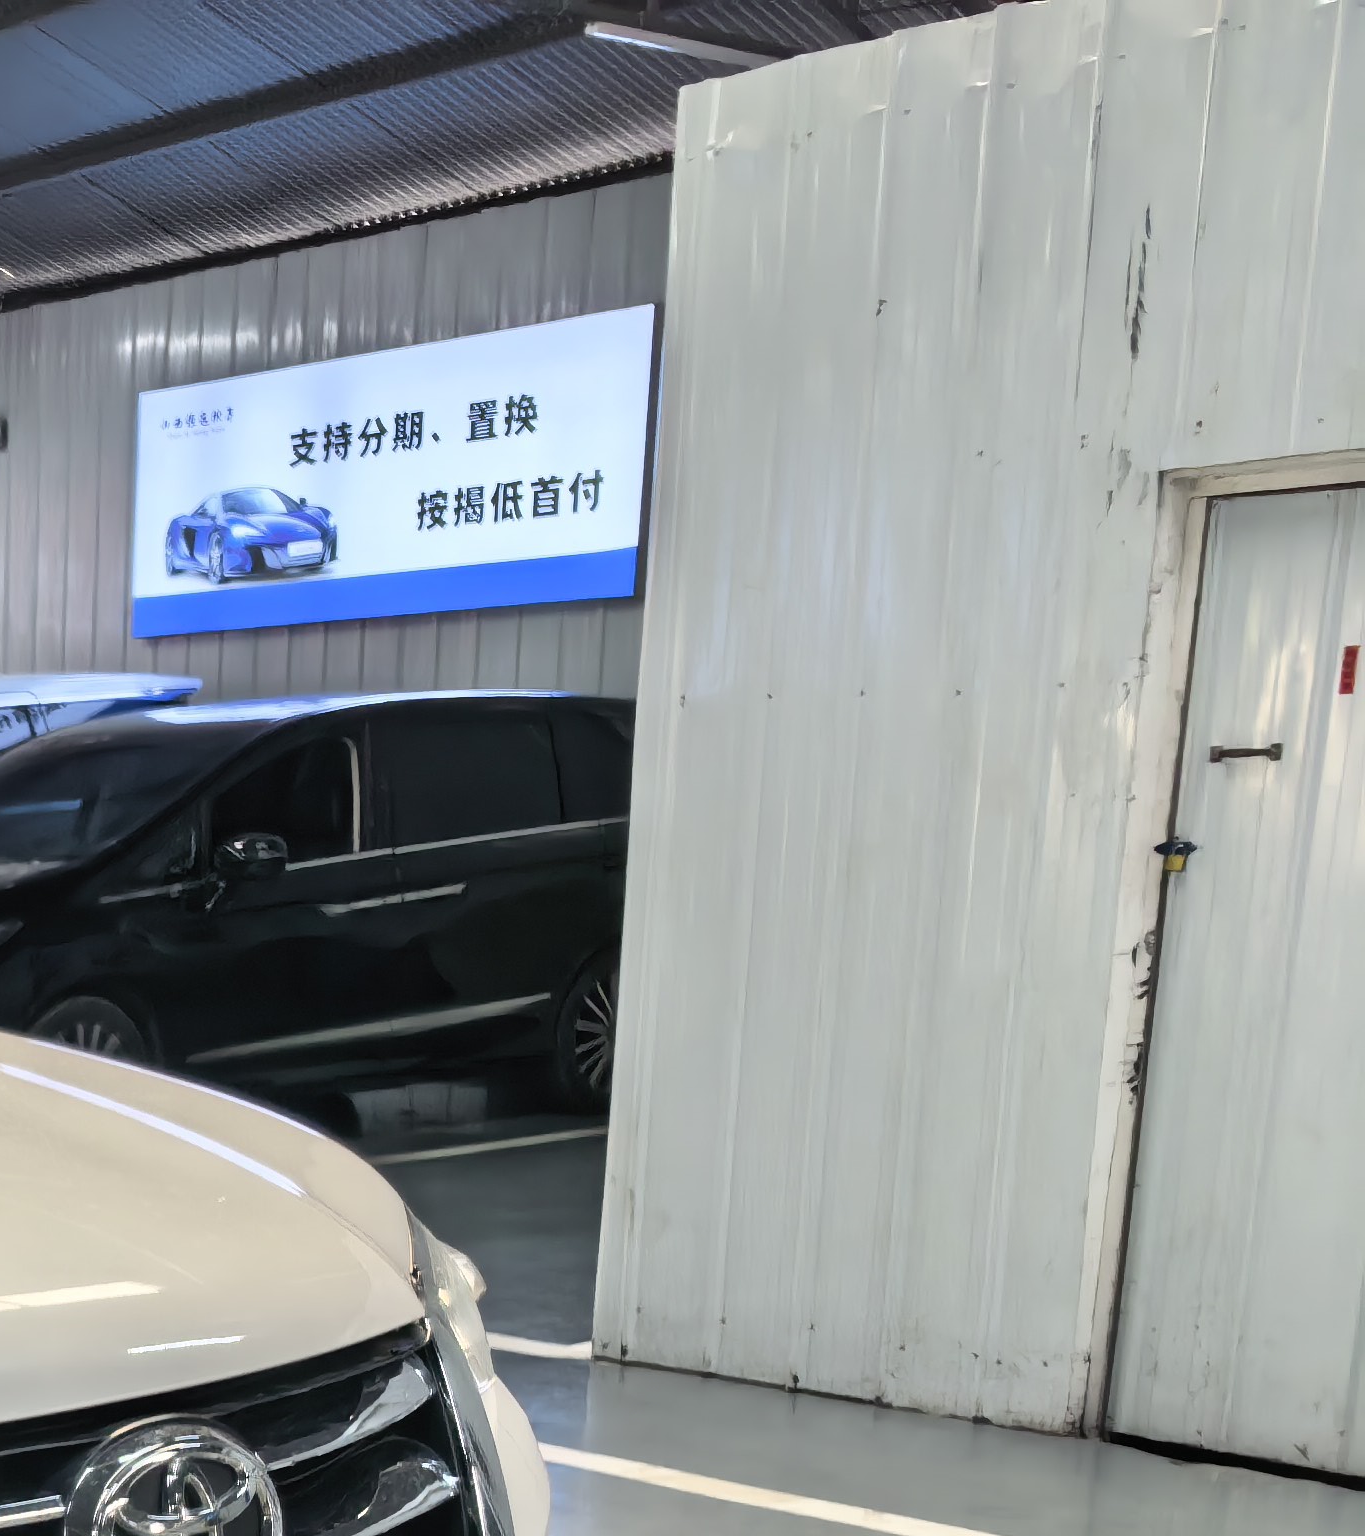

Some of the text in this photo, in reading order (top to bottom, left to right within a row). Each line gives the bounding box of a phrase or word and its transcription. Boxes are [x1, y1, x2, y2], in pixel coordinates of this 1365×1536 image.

[289, 394, 539, 467] 支持分期、置换
[417, 469, 604, 532] 按揭低首付
